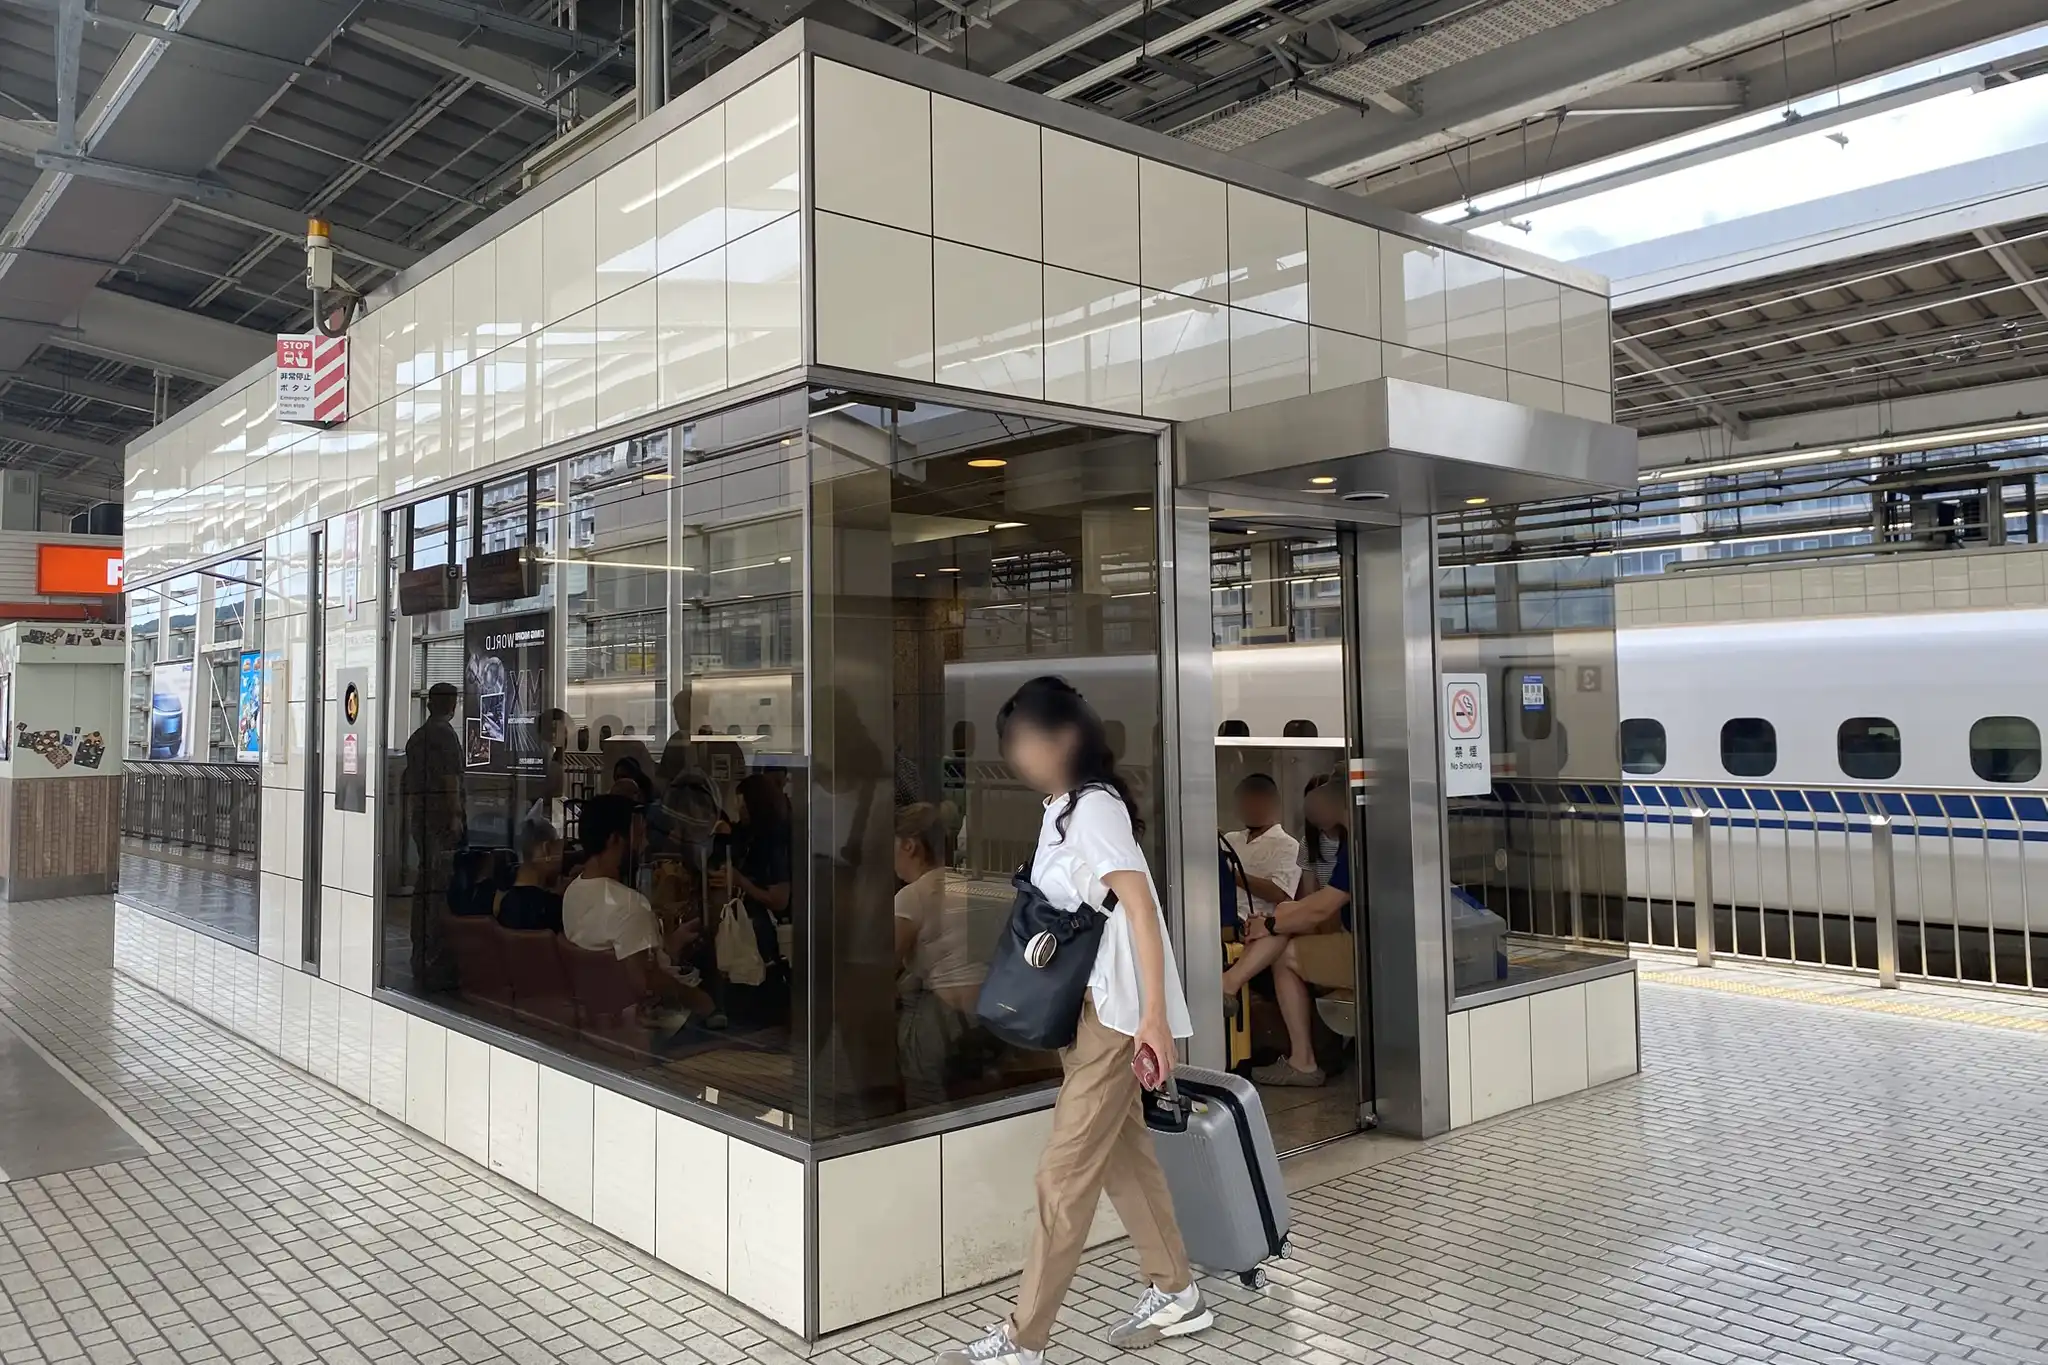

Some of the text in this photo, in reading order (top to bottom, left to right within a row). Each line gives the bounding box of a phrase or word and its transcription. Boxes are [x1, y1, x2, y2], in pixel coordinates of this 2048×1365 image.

[283, 341, 310, 350] STOP
[280, 372, 312, 381] 非常停止
[280, 384, 312, 392] ボタン
[1455, 745, 1478, 758] 禁煙
[1450, 761, 1483, 771] No Smoking
